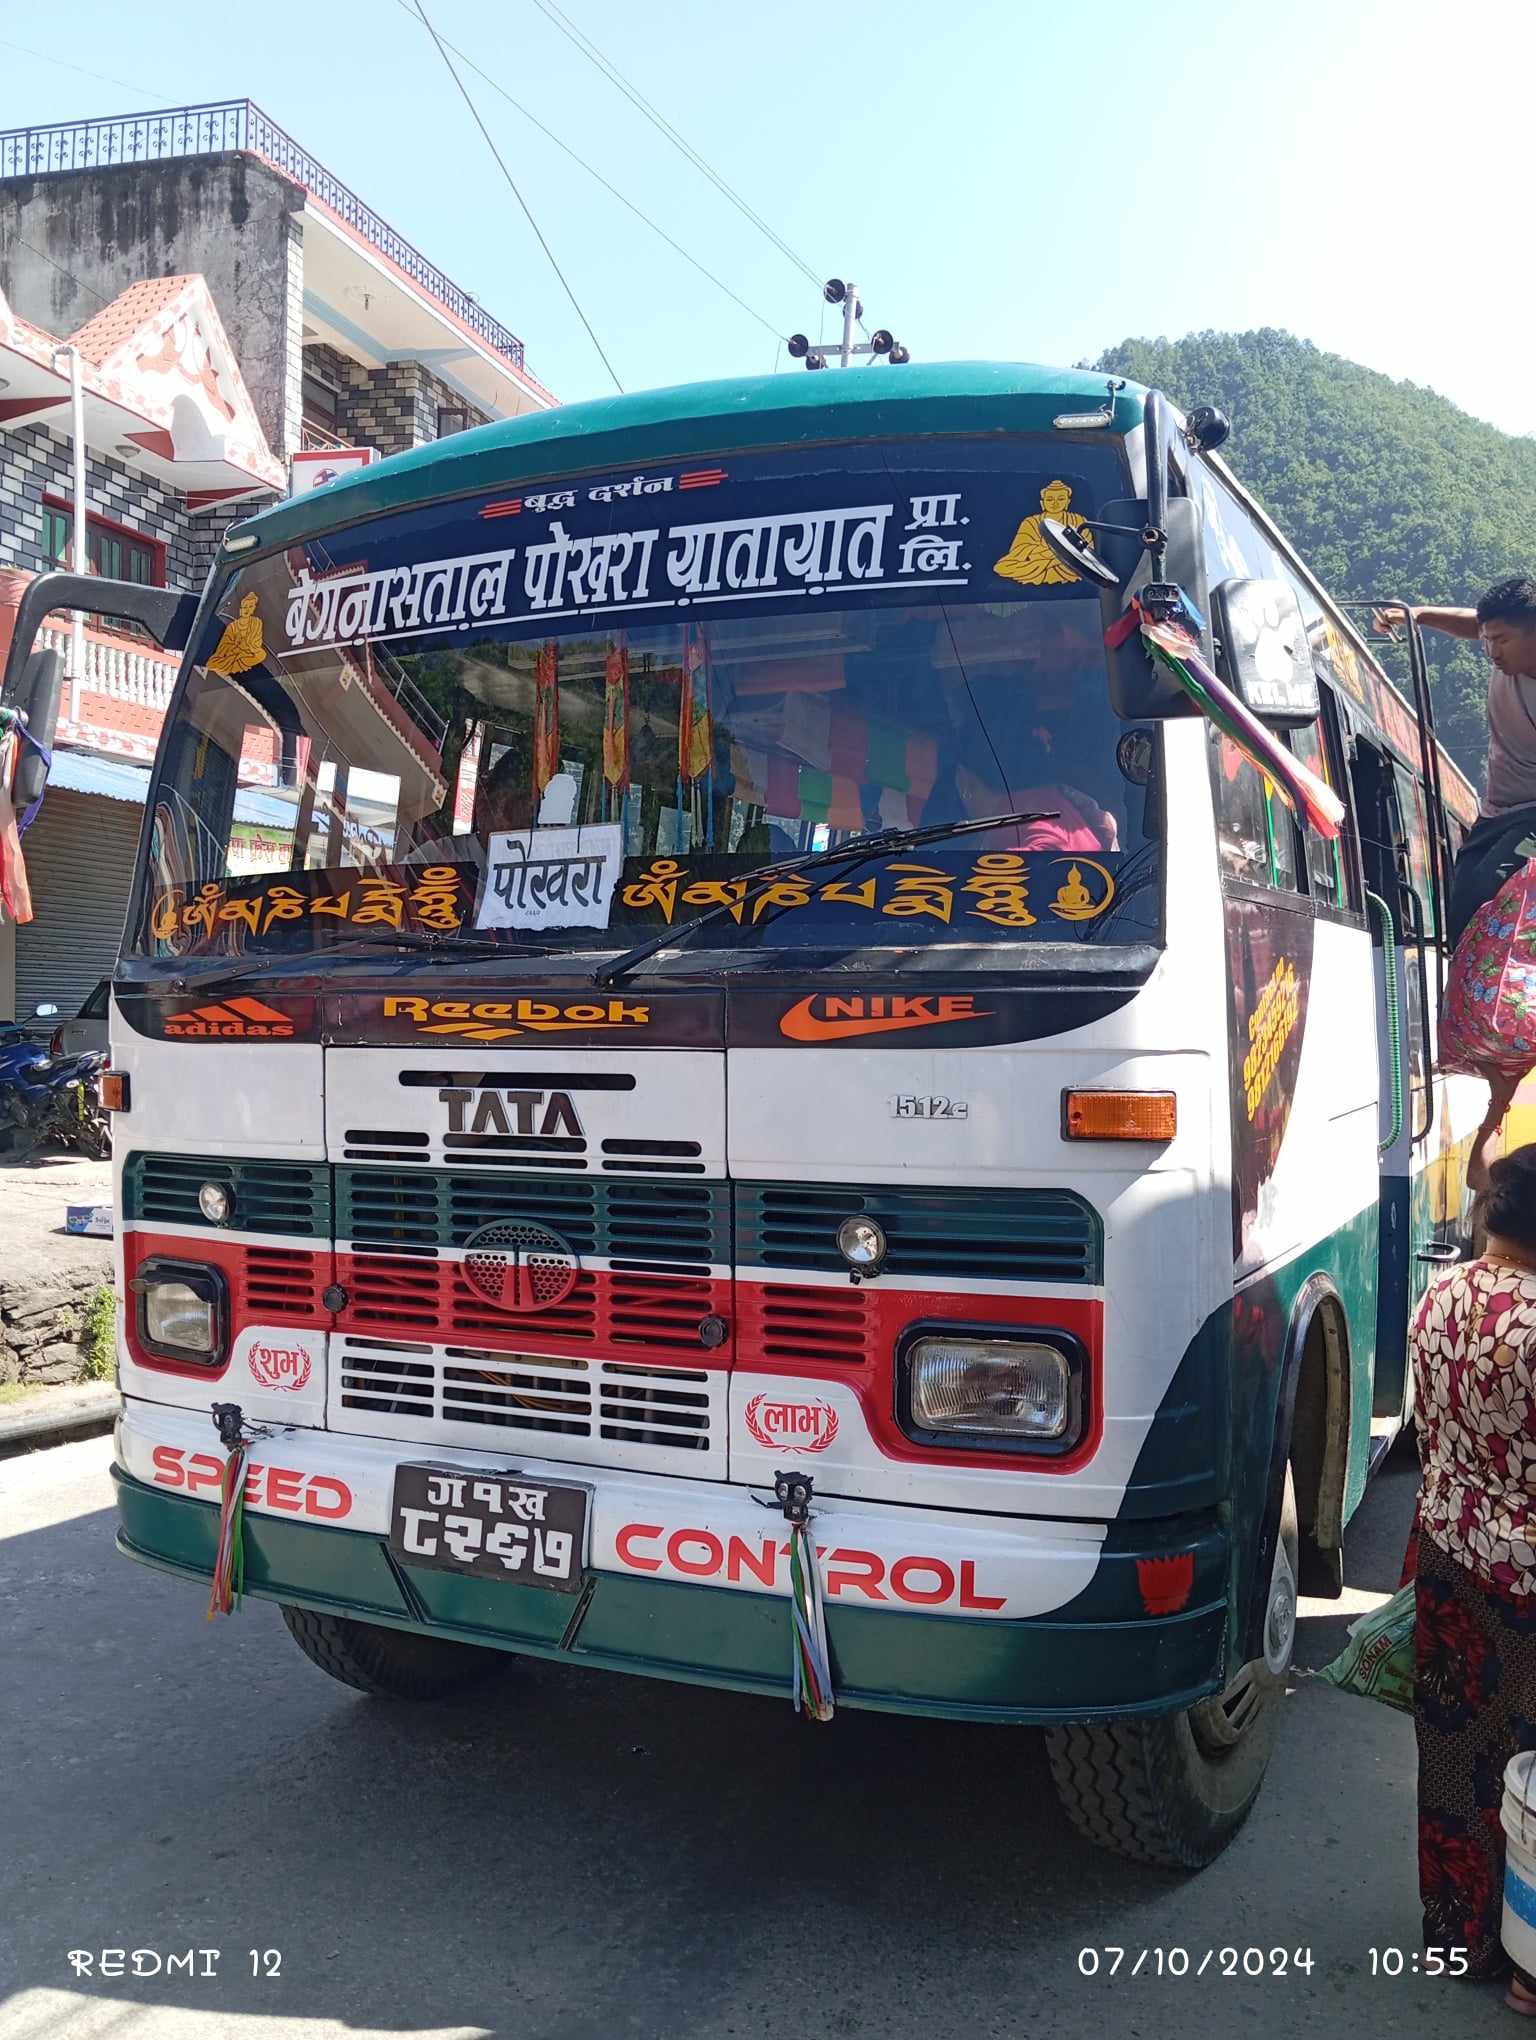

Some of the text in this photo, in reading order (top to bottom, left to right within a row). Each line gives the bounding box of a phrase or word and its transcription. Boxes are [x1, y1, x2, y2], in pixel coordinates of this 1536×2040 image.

[588, 476, 674, 503] दर्शन
[524, 521, 660, 610] पोखरा
[666, 504, 894, 593] यातायात
[904, 493, 970, 531] प्रा.
[898, 534, 973, 574] लि.
[493, 839, 607, 909] पोखरा
[383, 996, 649, 1023] Reebok
[825, 994, 977, 1018] NIKE
[164, 1021, 295, 1037] adidas
[439, 1088, 586, 1137] TATA
[763, 1402, 822, 1436] लाभ
